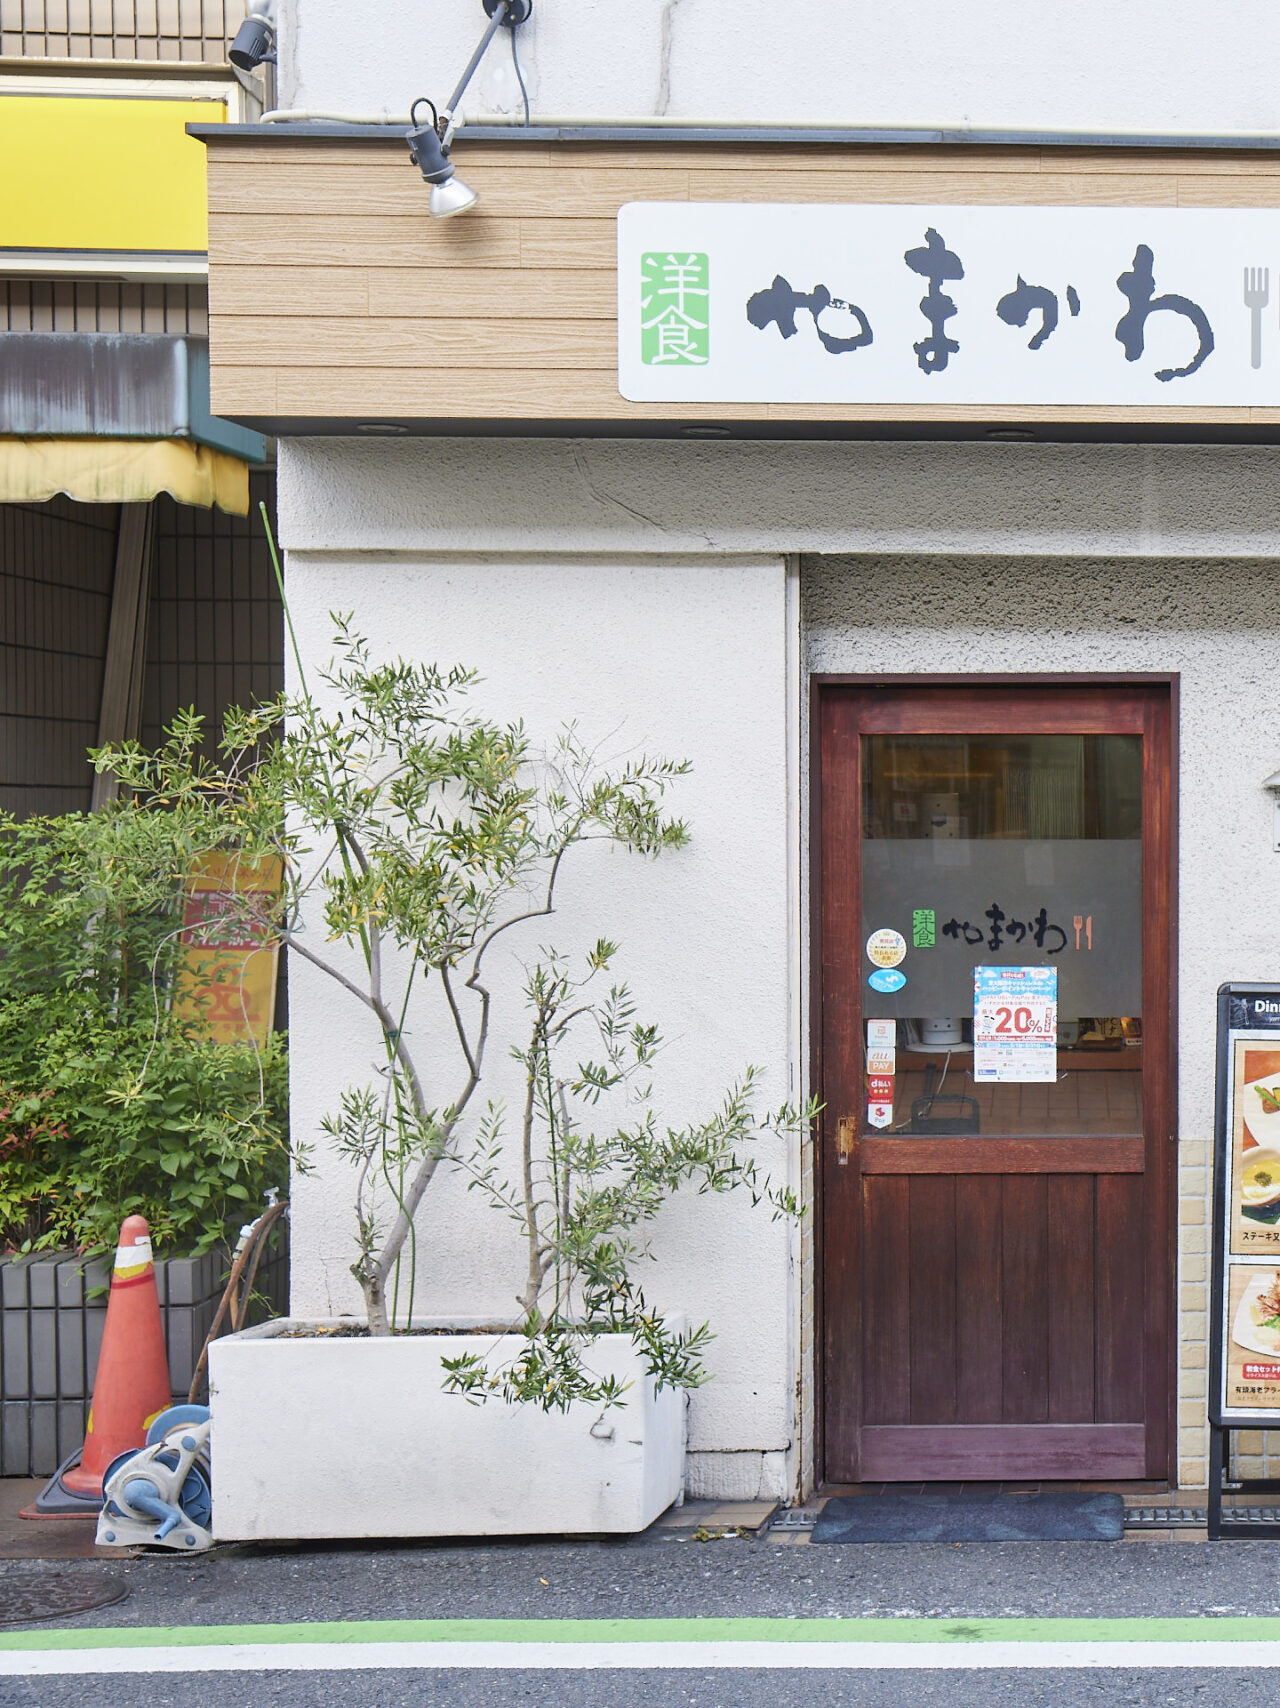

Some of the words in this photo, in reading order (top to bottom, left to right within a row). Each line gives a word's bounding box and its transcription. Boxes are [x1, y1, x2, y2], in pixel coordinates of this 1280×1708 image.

[642, 254, 708, 364] 洋食
[745, 227, 1214, 382] やまかわ
[913, 910, 936, 948] 洋食
[942, 903, 1068, 954] やまかわ
[995, 1007, 1043, 1033] 20%
[872, 1062, 890, 1070] PAY
